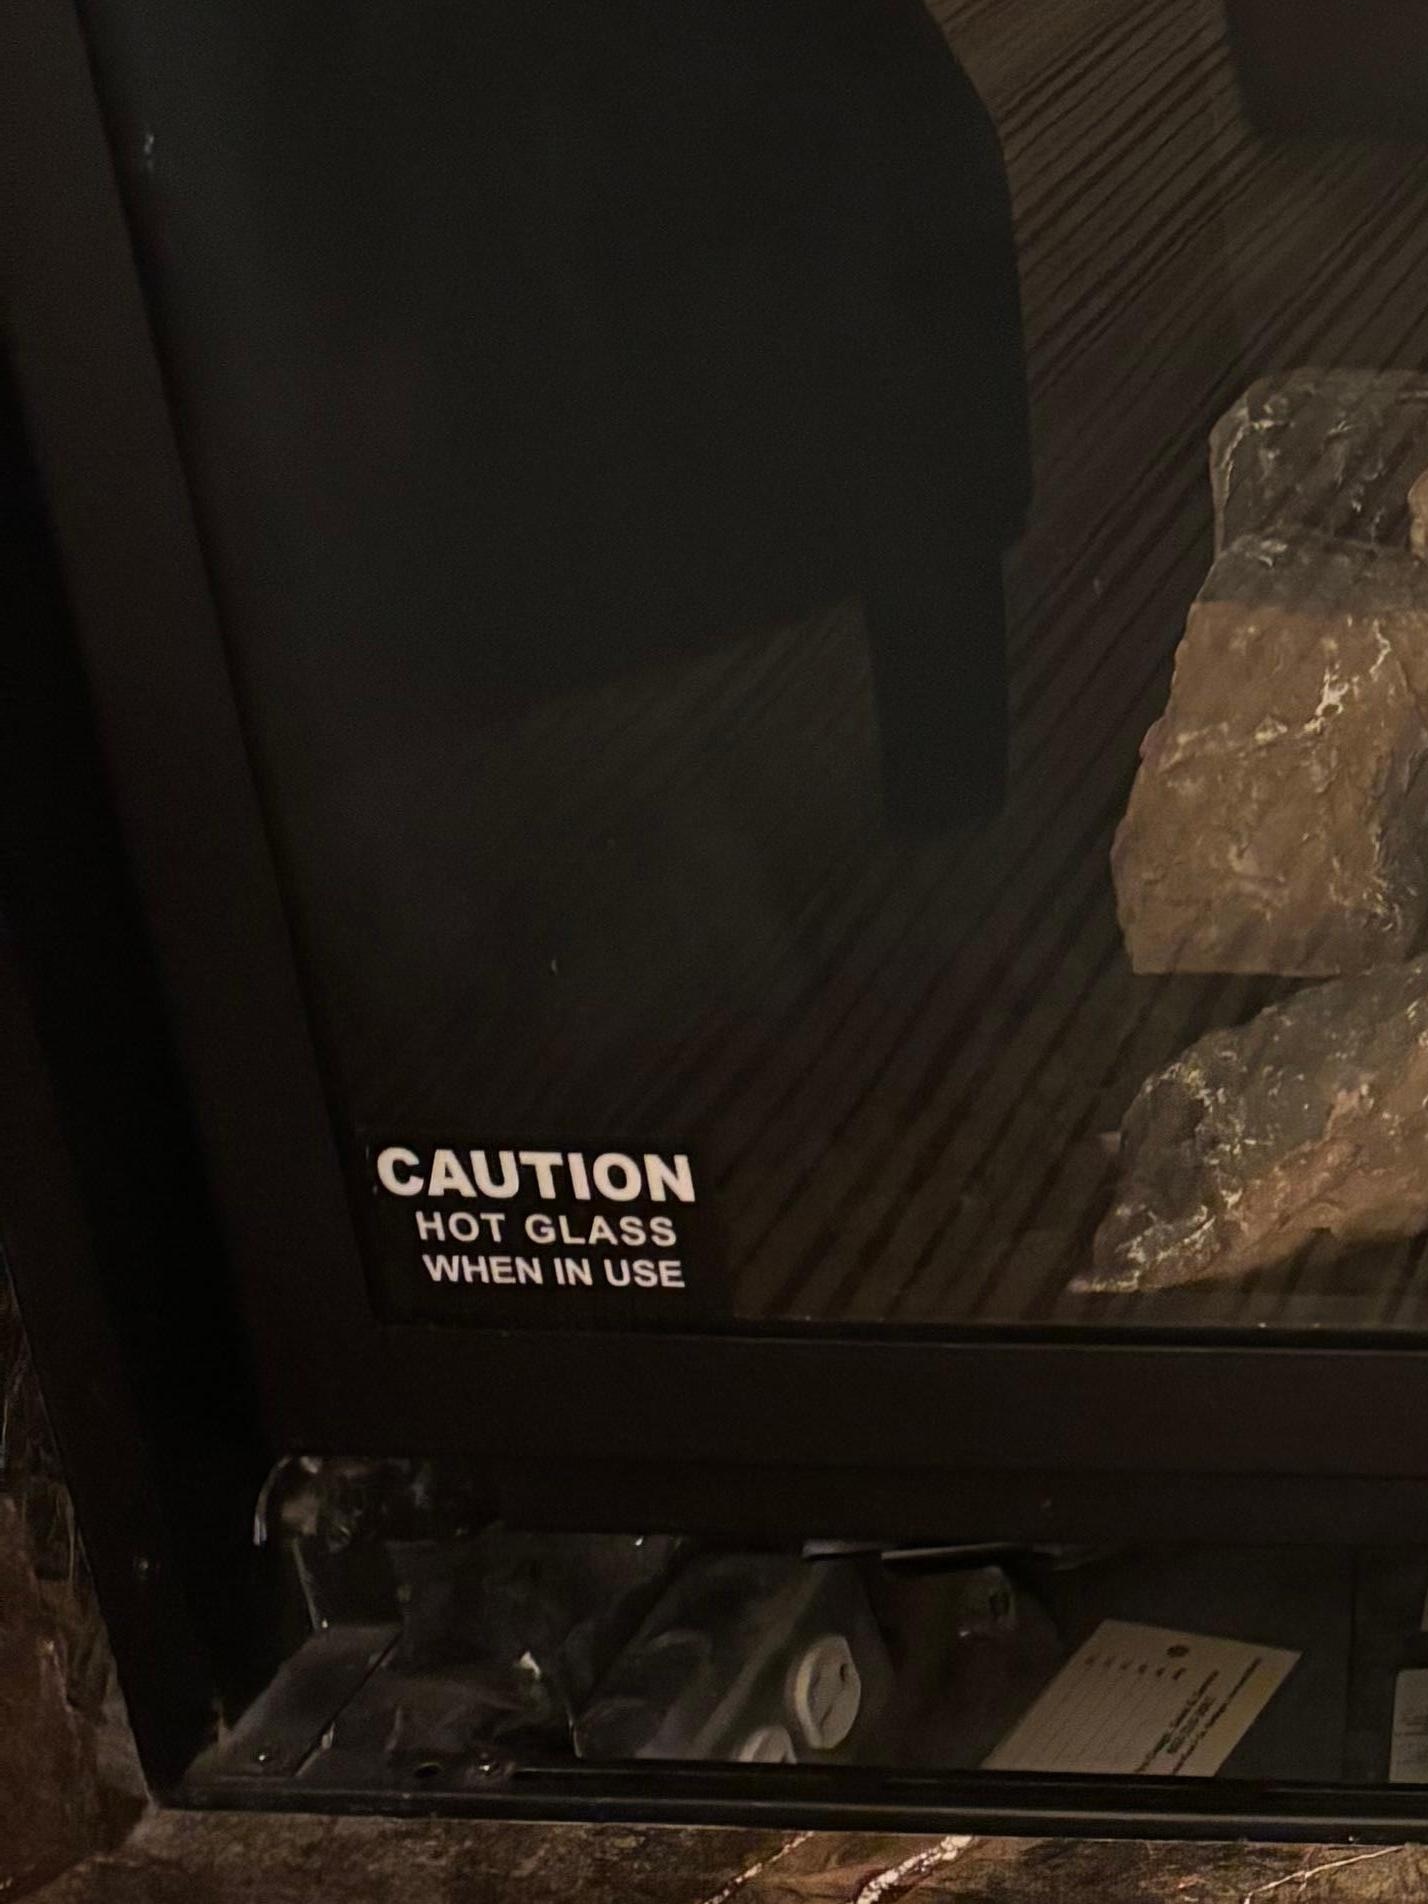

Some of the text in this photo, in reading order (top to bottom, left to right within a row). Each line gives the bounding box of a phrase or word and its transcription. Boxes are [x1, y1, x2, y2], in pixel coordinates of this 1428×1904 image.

[377, 1147, 696, 1202] CAUTION
[416, 1211, 677, 1247] HOT GLASS
[423, 1254, 685, 1288] WHEN IN USE
